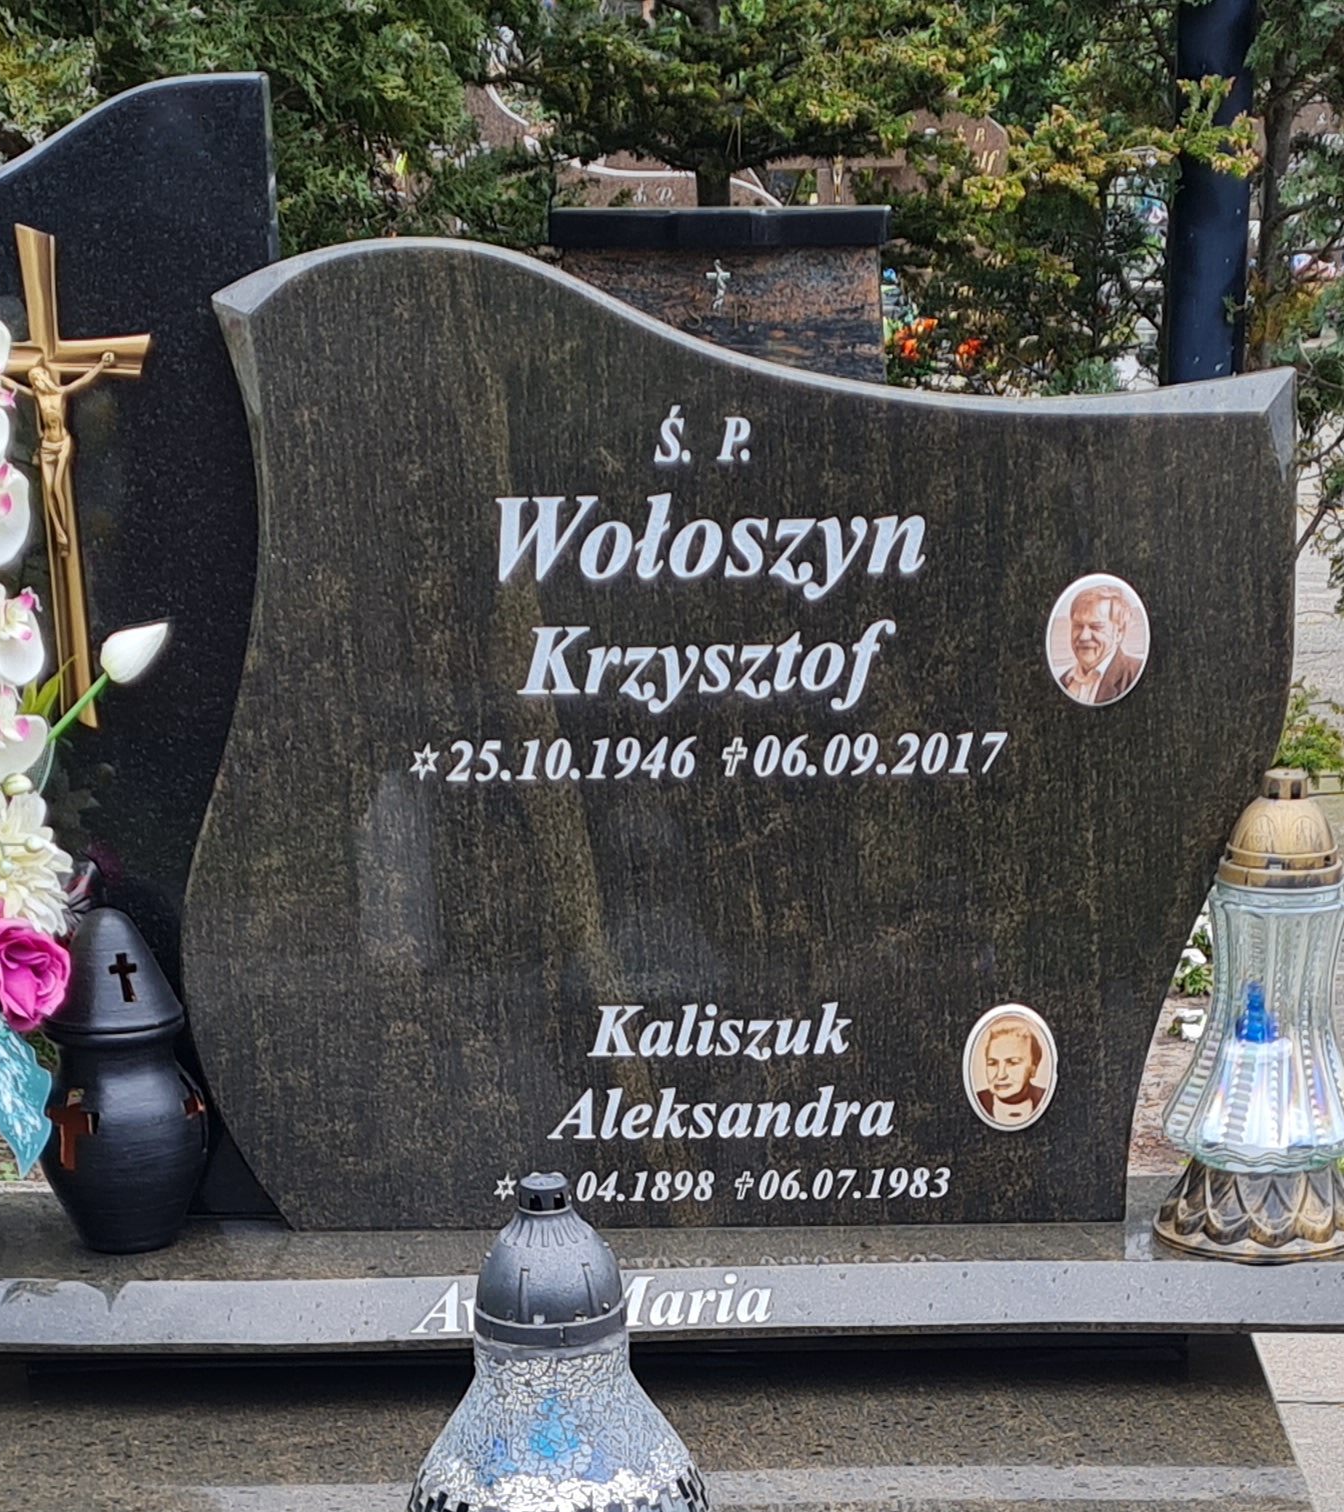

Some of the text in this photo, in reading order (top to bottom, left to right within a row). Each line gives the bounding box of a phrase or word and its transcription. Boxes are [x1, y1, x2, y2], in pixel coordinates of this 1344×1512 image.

[494, 492, 926, 601] Wołoszyn
[517, 619, 896, 713] Krzysztof
[446, 731, 1008, 782] 25.10.1946 06.09.2017
[587, 1001, 853, 1060] Kaliszuk
[547, 1086, 895, 1140] Aleksandra
[528, 1167, 953, 1203] .04.1898 06.07.1983
